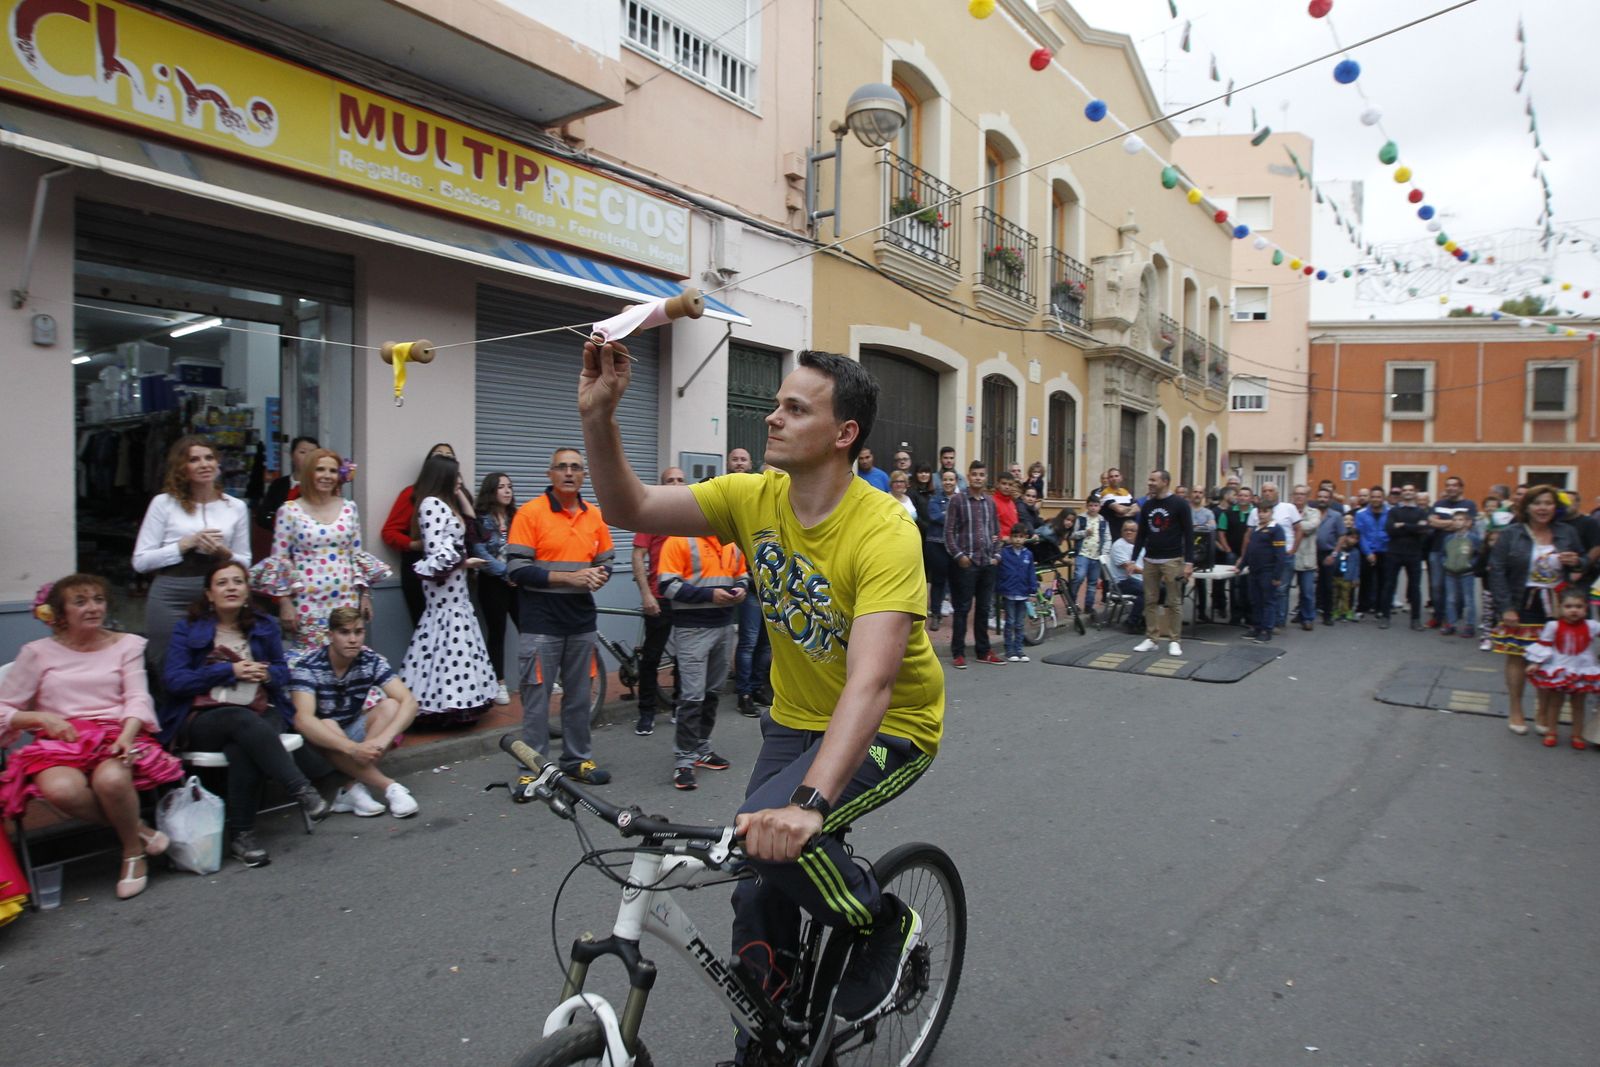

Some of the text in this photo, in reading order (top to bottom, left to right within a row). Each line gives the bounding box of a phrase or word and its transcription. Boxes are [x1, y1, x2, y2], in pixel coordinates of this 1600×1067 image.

[9, 0, 279, 148] Chino
[338, 149, 423, 189] Regalos
[515, 203, 556, 229] Ropa
[339, 92, 686, 246] MULTIPRECIOS
[1344, 462, 1356, 479] P
[686, 937, 765, 1031] MERIDA
